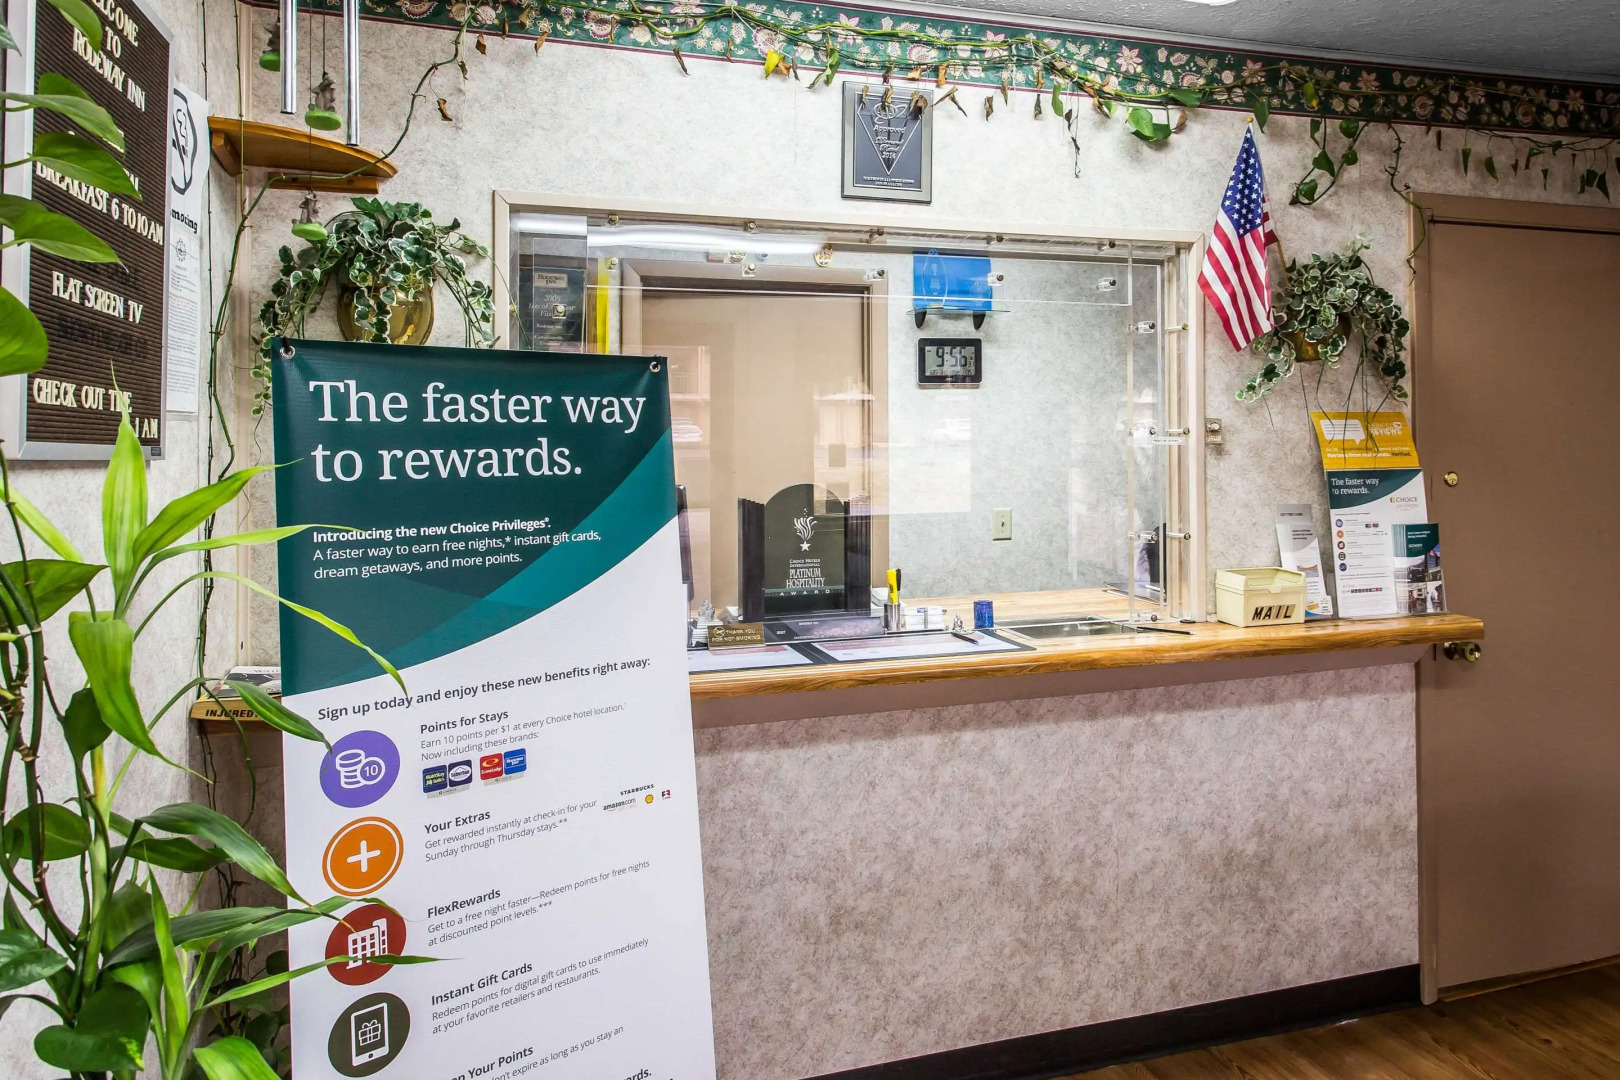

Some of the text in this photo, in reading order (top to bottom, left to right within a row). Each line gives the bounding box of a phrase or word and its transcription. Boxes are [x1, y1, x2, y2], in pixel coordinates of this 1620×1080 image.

[92, 0, 138, 47] LCOME
[105, 26, 121, 58] TO
[73, 27, 145, 111] RODEWAY INN
[36, 160, 109, 214] BREAKFAST
[111, 198, 119, 220] 6
[122, 203, 136, 230] TO
[137, 213, 148, 236] 10
[148, 221, 163, 246] AM
[52, 271, 83, 304] FLAT
[85, 284, 124, 318] SCREEN
[128, 300, 144, 324] TV
[33, 377, 77, 408] CHECK
[81, 385, 106, 411] OUT
[309, 379, 646, 433] The faster way
[141, 417, 158, 439] AM
[311, 437, 582, 482] to rewards.
[1331, 478, 1344, 486] The
[1365, 478, 1379, 486] way
[313, 528, 393, 543] Introducing
[395, 526, 417, 538] the
[420, 526, 447, 536] new
[450, 522, 490, 534] Choice
[313, 550, 323, 561] A
[326, 548, 365, 560] faster
[368, 546, 393, 558] way
[396, 545, 409, 555] to
[412, 543, 440, 553] earn
[442, 540, 466, 551] free
[514, 534, 551, 546] instant
[552, 531, 569, 545] gift
[571, 530, 602, 542] cards,
[314, 553, 522, 579] dream getaways, and more points.
[786, 577, 825, 589] HOSPITALITY
[789, 568, 821, 578] PLATINUM
[1252, 605, 1294, 621] MAIL
[318, 657, 651, 721] Sign up today and enjoy these new benefits right away:
[420, 710, 509, 734] Points for Stays
[421, 738, 442, 749] Earn
[443, 735, 455, 745] 10
[456, 730, 483, 745] points
[484, 728, 499, 741] per
[501, 724, 511, 734] $1
[513, 722, 521, 731] at
[522, 719, 545, 732] every
[546, 714, 572, 725] Choice
[573, 709, 593, 720] hotel
[421, 731, 540, 761] Now including these brands:
[363, 764, 379, 777] 10
[620, 783, 655, 796] STARBUCKS
[424, 811, 491, 834] Your Extras
[425, 800, 597, 850] Get rewarded instantly at check-in for your
[425, 847, 459, 863] Sunday
[460, 836, 496, 853] through
[497, 825, 535, 843] Thursday
[427, 923, 444, 934] Get
[446, 919, 456, 928] to
[457, 917, 463, 925] a
[465, 910, 483, 923] free
[484, 903, 507, 919] night
[574, 875, 598, 890] points
[599, 871, 611, 882] for
[611, 867, 627, 878] free
[627, 860, 650, 875] nights
[427, 888, 501, 918] FlexRewards
[428, 936, 438, 947] at
[439, 920, 489, 943] discounted
[490, 914, 513, 929] point
[431, 962, 533, 1006] Instant Gift Cards
[432, 937, 649, 1021] Redeem points for digital gift cards to use immediately
[432, 966, 602, 1035] at your favorite retailers and restaurants.
[468, 1046, 534, 1080] Your Points
[512, 1025, 624, 1077] expire as long as you stay an
